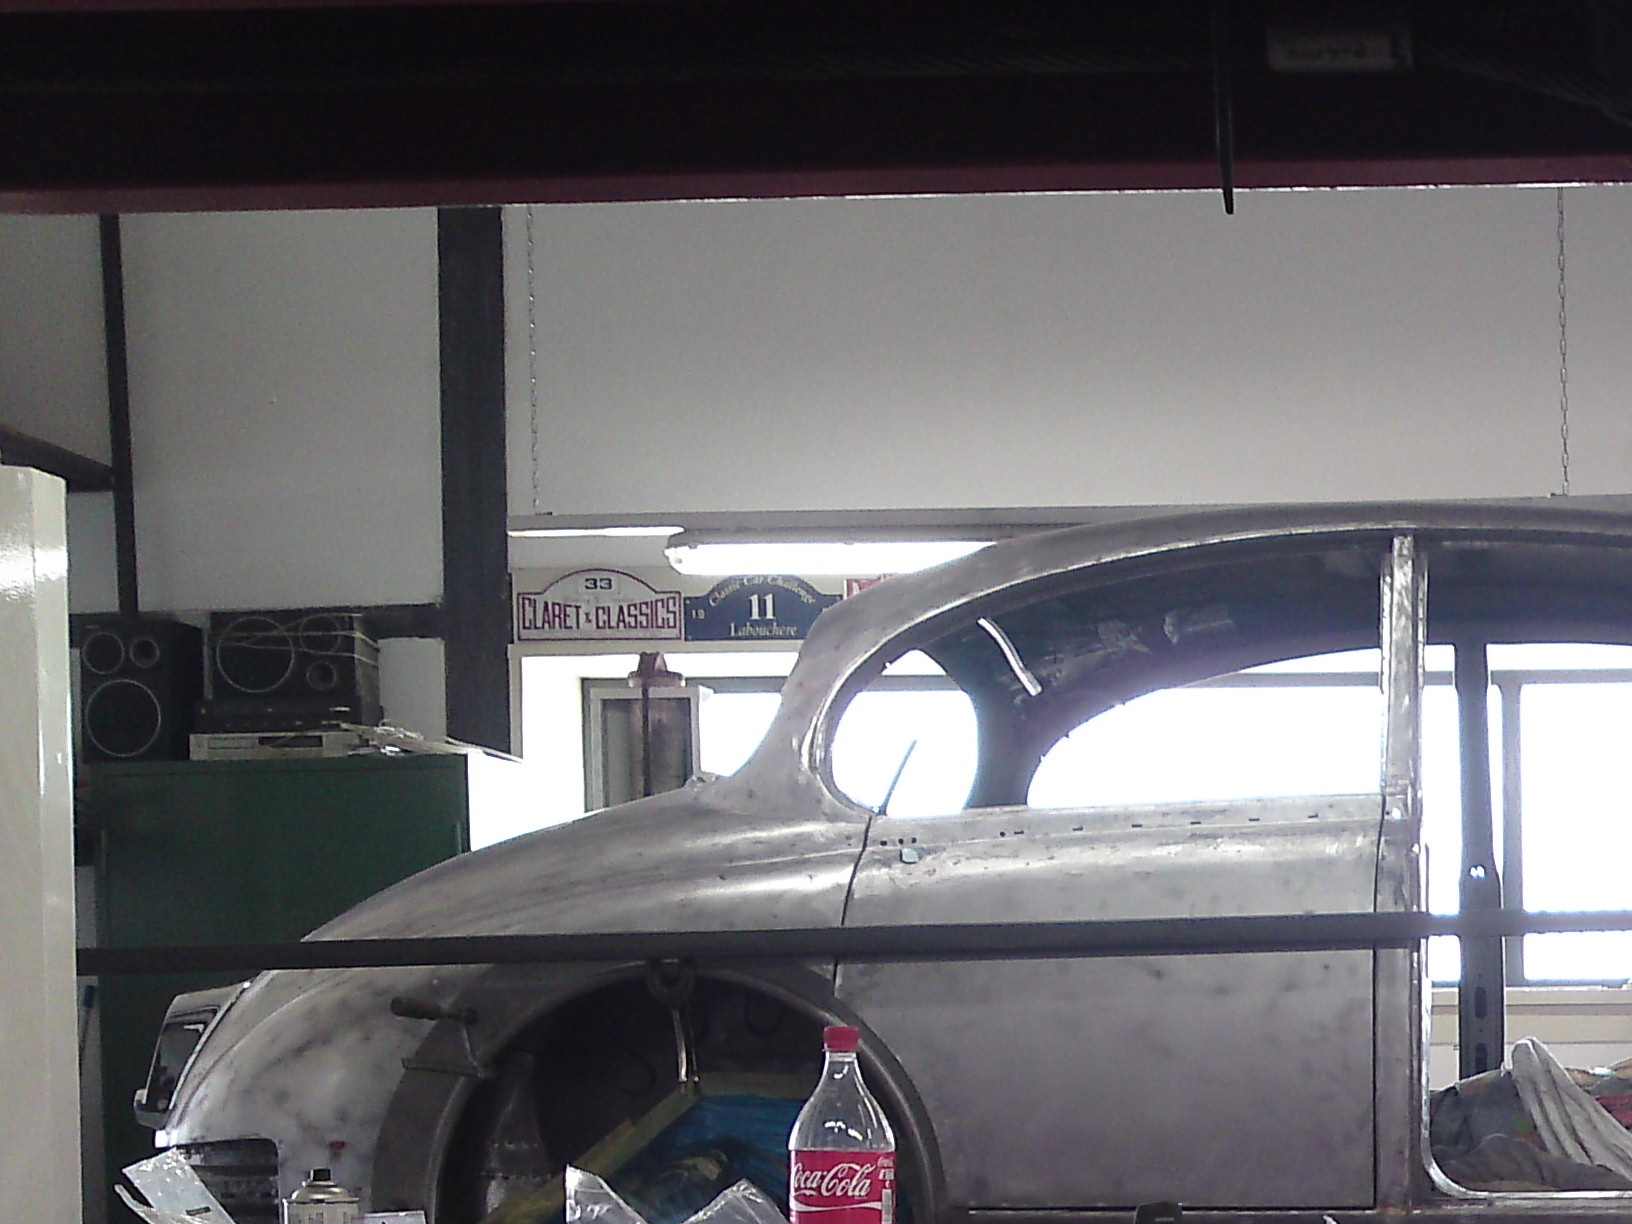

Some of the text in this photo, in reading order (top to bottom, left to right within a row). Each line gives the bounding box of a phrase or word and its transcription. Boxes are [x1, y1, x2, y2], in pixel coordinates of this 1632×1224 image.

[584, 577, 613, 590] 33
[521, 596, 581, 630] CLARET
[595, 597, 677, 630] CLASSICS
[748, 593, 776, 620] 11
[730, 621, 798, 637] Labouchere
